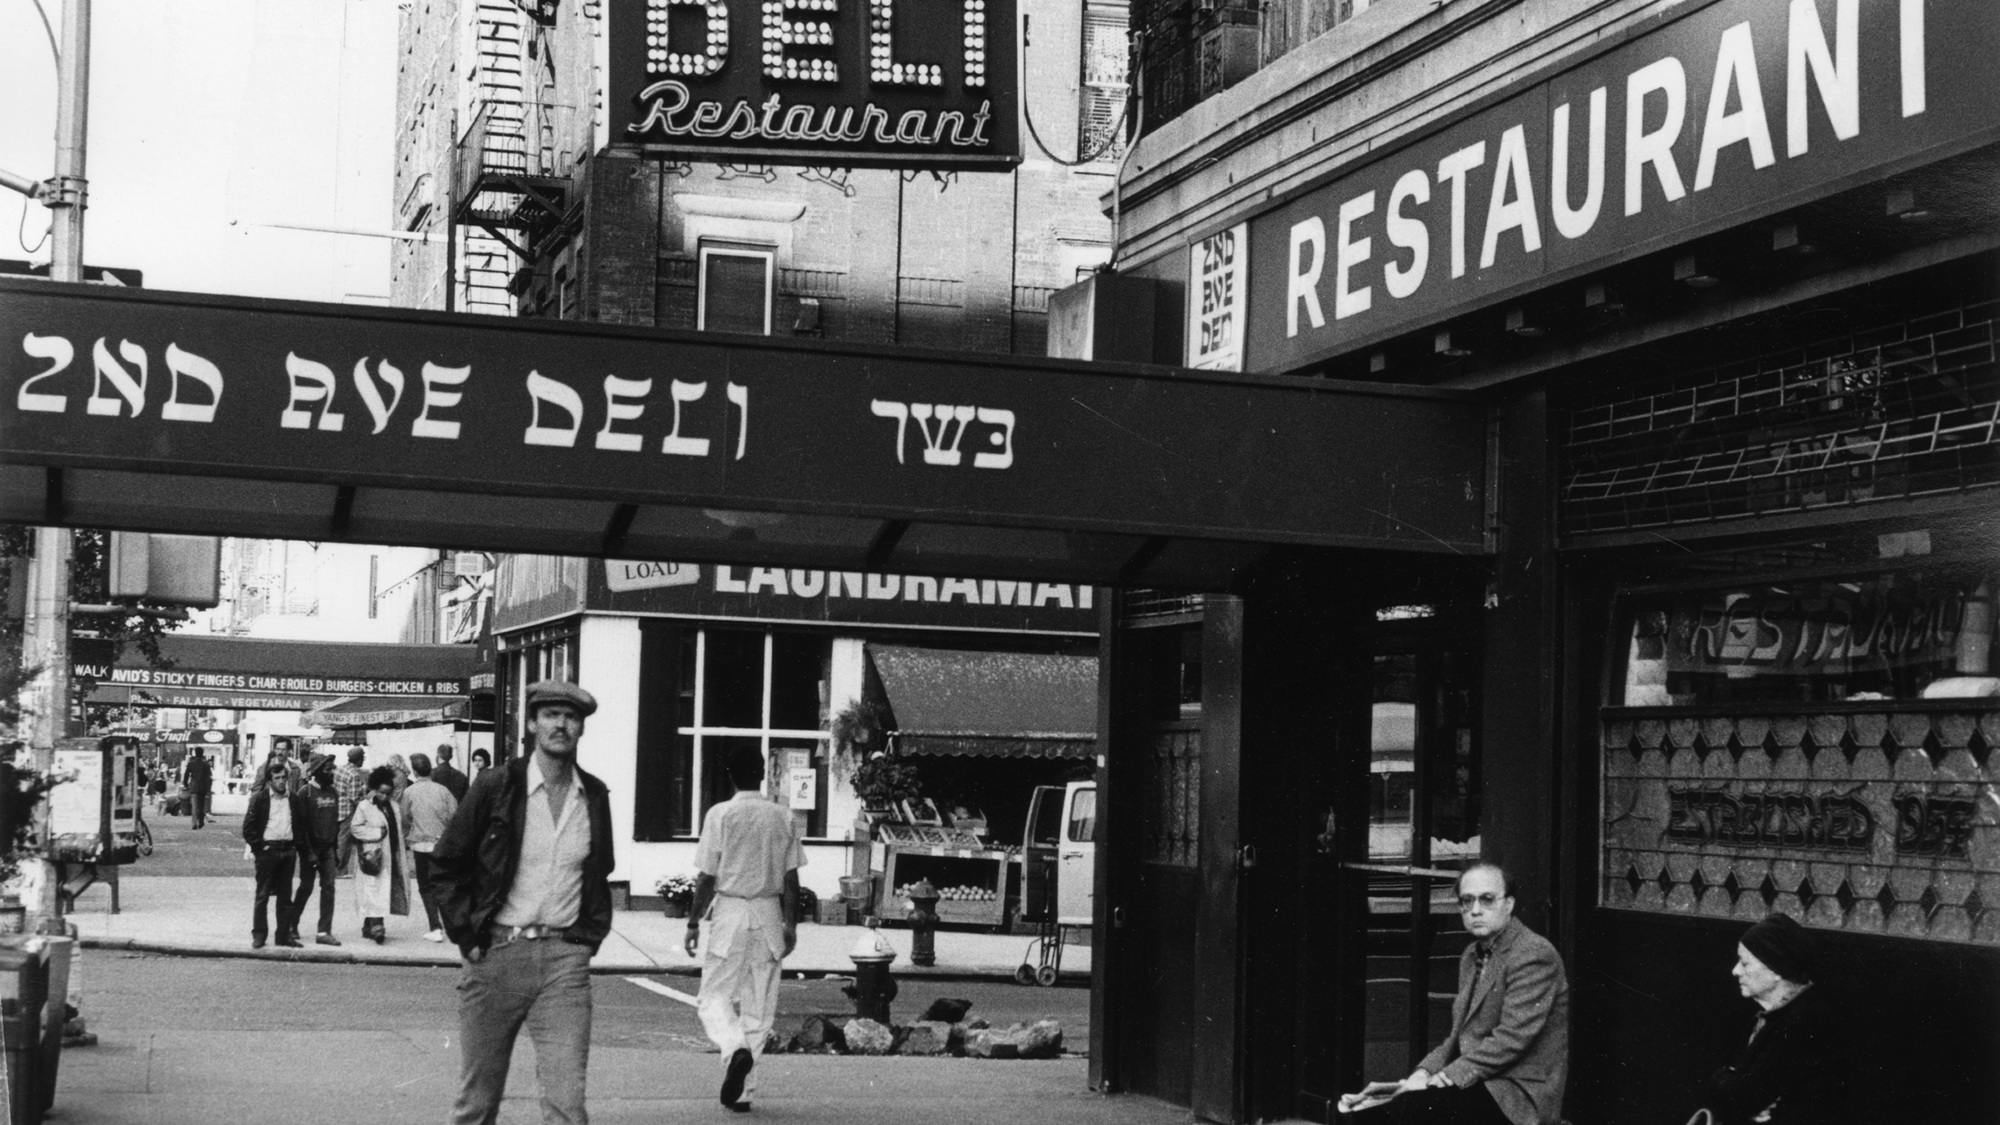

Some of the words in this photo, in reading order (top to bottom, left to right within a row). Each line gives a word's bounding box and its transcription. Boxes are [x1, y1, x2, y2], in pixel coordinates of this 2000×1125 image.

[646, 0, 985, 87] DELI
[627, 80, 990, 146] Restaurant
[1203, 230, 1235, 275] 2ND
[1202, 270, 1234, 315] AVE
[17, 331, 225, 423] 2ND
[281, 350, 472, 440] AVE
[524, 369, 748, 461] DELI
[624, 561, 681, 580] LOAD
[74, 664, 109, 677] WALK
[111, 669, 151, 684] AVID'S
[153, 671, 195, 686] STICKY
[196, 674, 246, 688] FINGERS
[436, 682, 460, 694] RIBS
[173, 695, 223, 706] FALAFEL
[231, 697, 301, 709] VEGETARIAN
